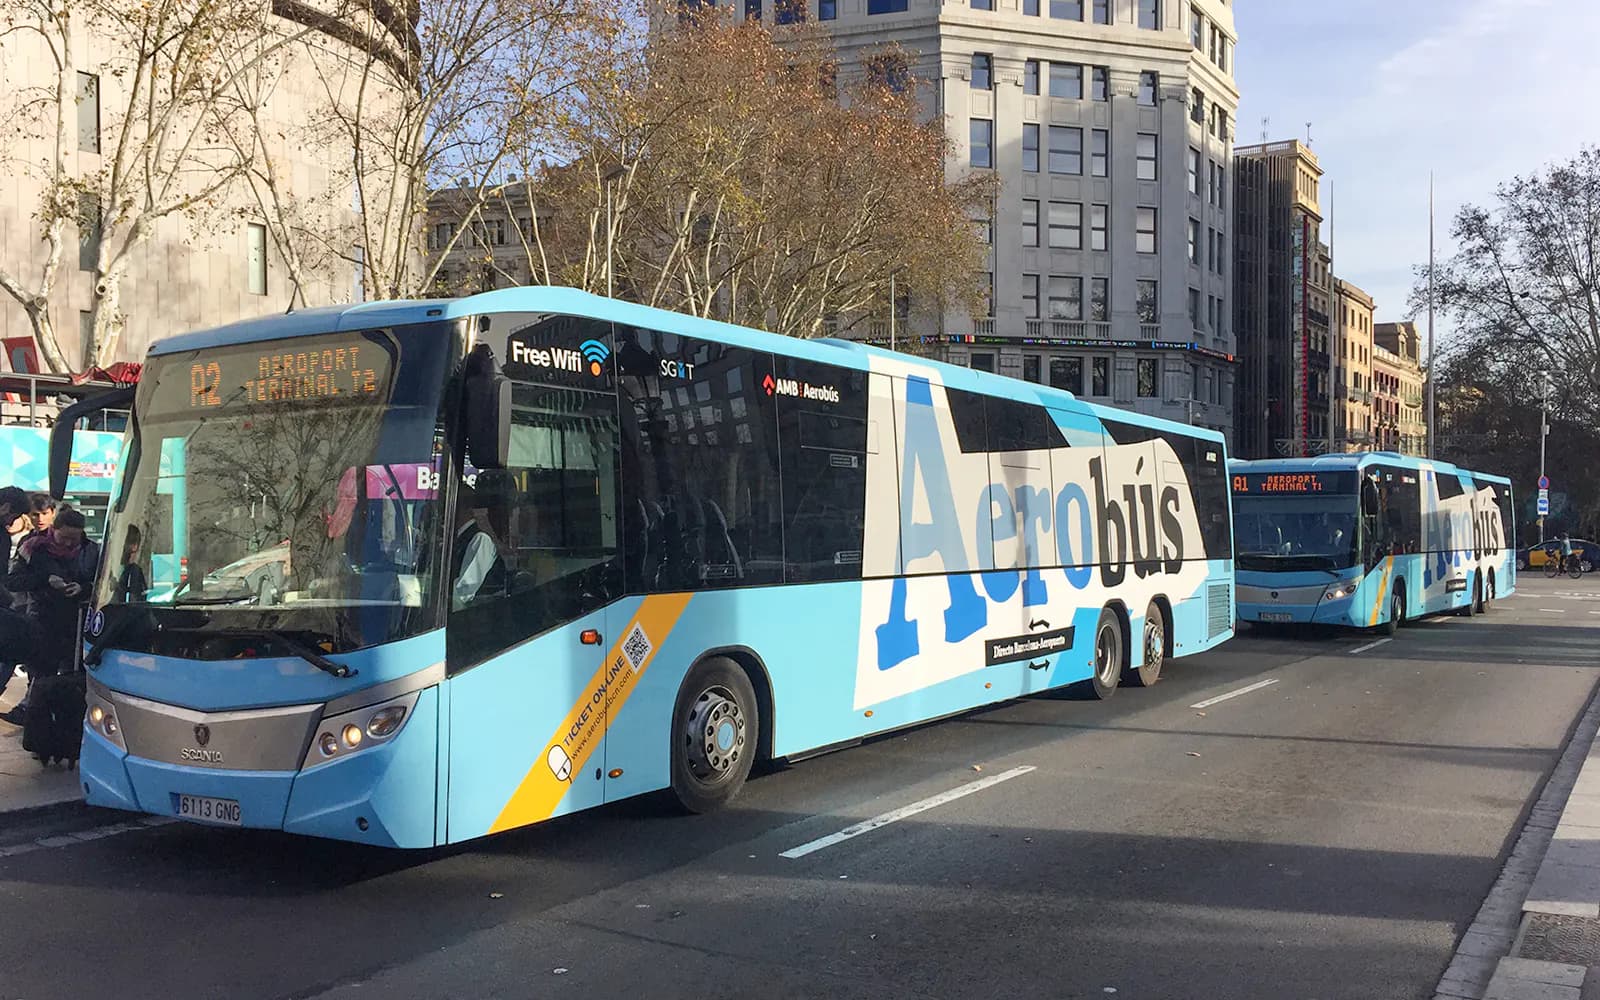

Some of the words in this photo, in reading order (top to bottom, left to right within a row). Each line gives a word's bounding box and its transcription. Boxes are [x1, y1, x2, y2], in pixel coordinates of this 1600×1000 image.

[259, 347, 359, 379] AEROPORT
[512, 340, 550, 367] Free
[551, 347, 582, 372] Wifi
[191, 361, 221, 406] A2
[776, 378, 799, 396] AMB
[803, 382, 839, 402] Aerobús
[1261, 482, 1307, 492] TERMINAL
[1267, 474, 1317, 484] AEROPORT
[875, 375, 1184, 671] Aerobús
[563, 702, 594, 747] TICKET
[592, 655, 625, 704] ON-LINE
[181, 748, 224, 763] SCANIA
[182, 797, 212, 817] 6113
[215, 802, 241, 821] GNG
